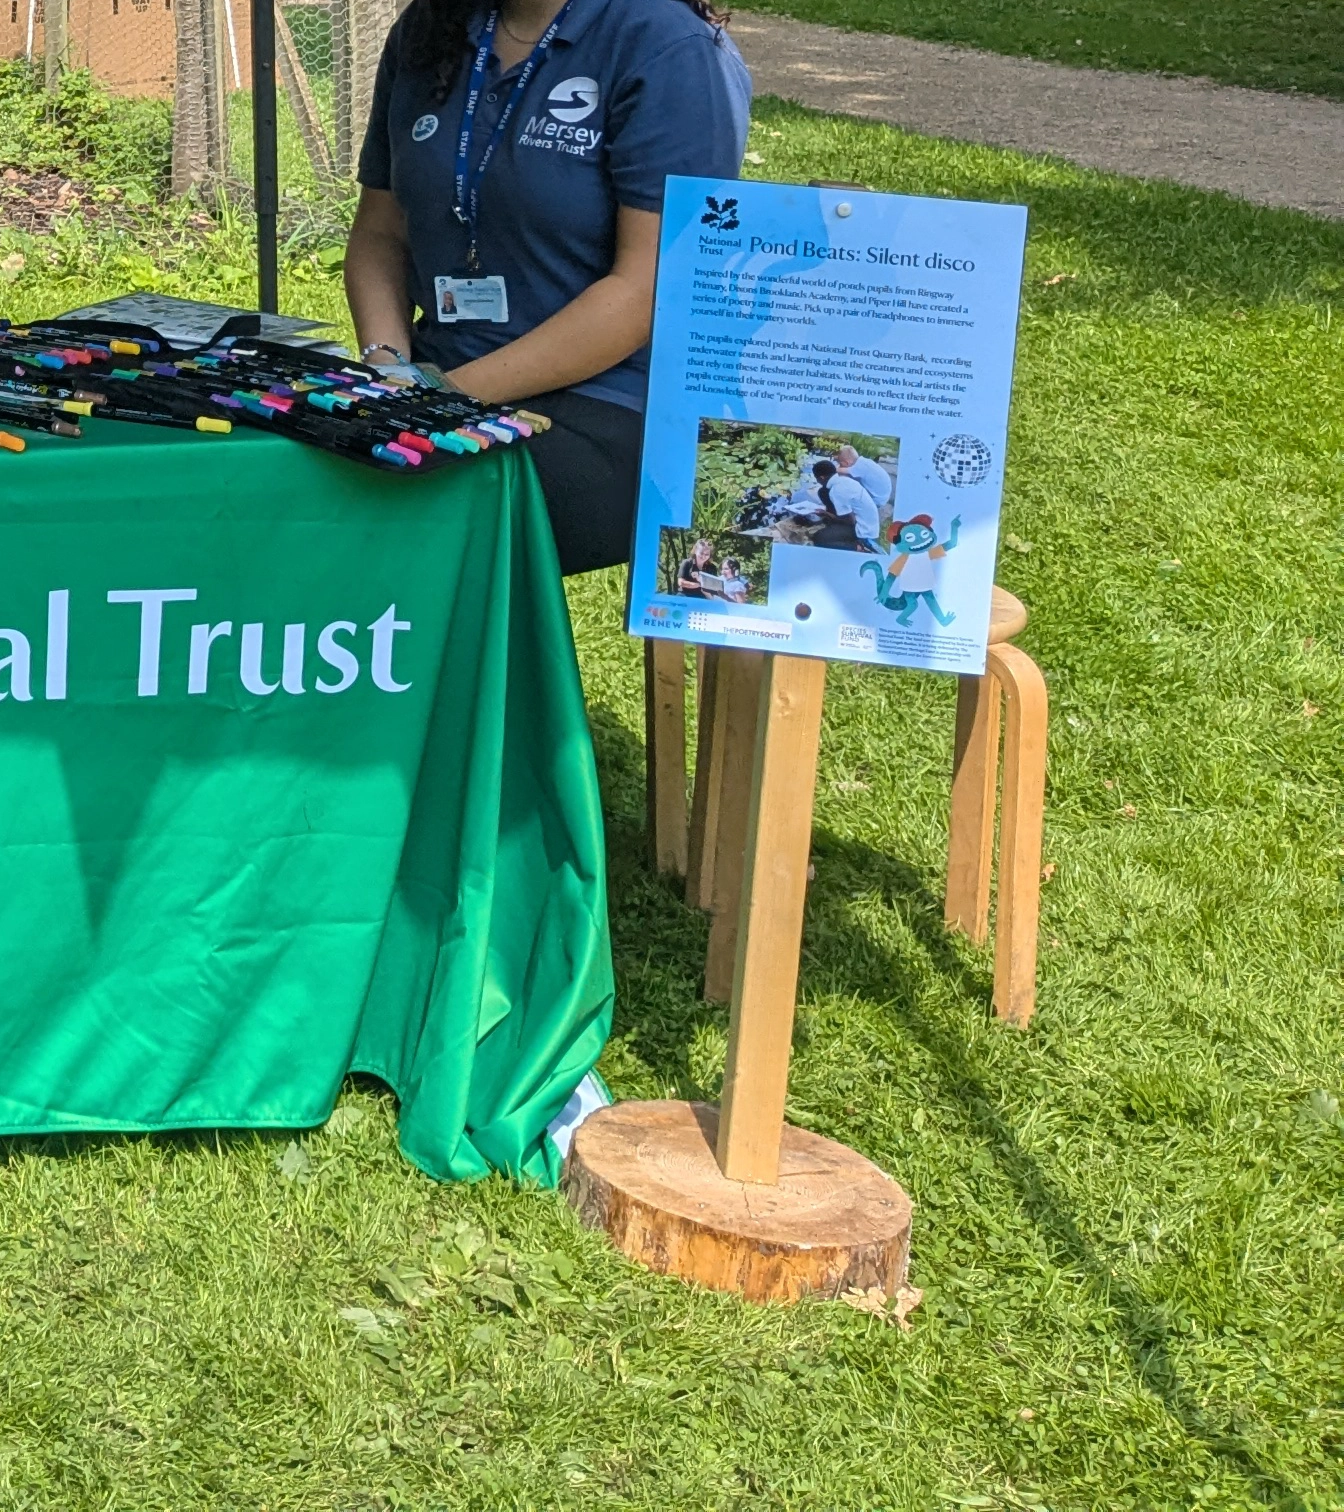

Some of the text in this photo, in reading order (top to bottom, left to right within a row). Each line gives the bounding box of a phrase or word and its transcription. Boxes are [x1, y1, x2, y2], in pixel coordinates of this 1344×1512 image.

[135, 4, 148, 14] UP
[539, 23, 559, 49] STAFF
[475, 47, 488, 72] STAFF
[518, 61, 533, 88] STAFF
[466, 90, 479, 116] STAFF
[498, 103, 512, 130] STAFF
[458, 131, 470, 158] STAFF
[518, 134, 586, 157] Rivers Trust
[524, 115, 603, 150] Mersey
[698, 234, 742, 249] National
[698, 244, 724, 257] Trust
[748, 237, 976, 273] Pond Beats: Silent disco
[692, 280, 727, 293] Primary,
[728, 283, 758, 293] Dixons
[759, 286, 807, 298] Brooklands
[808, 290, 848, 304] Academy,
[849, 294, 867, 303] and
[867, 296, 891, 308] Piper
[891, 298, 907, 307] Hill
[907, 299, 928, 309] have
[929, 301, 962, 312] created
[693, 267, 954, 301] Inspired by the wonderful world of ponds pupils from Ringway
[643, 618, 683, 629] RENEW
[841, 626, 867, 634] SPECIES
[107, 587, 414, 697] Trust
